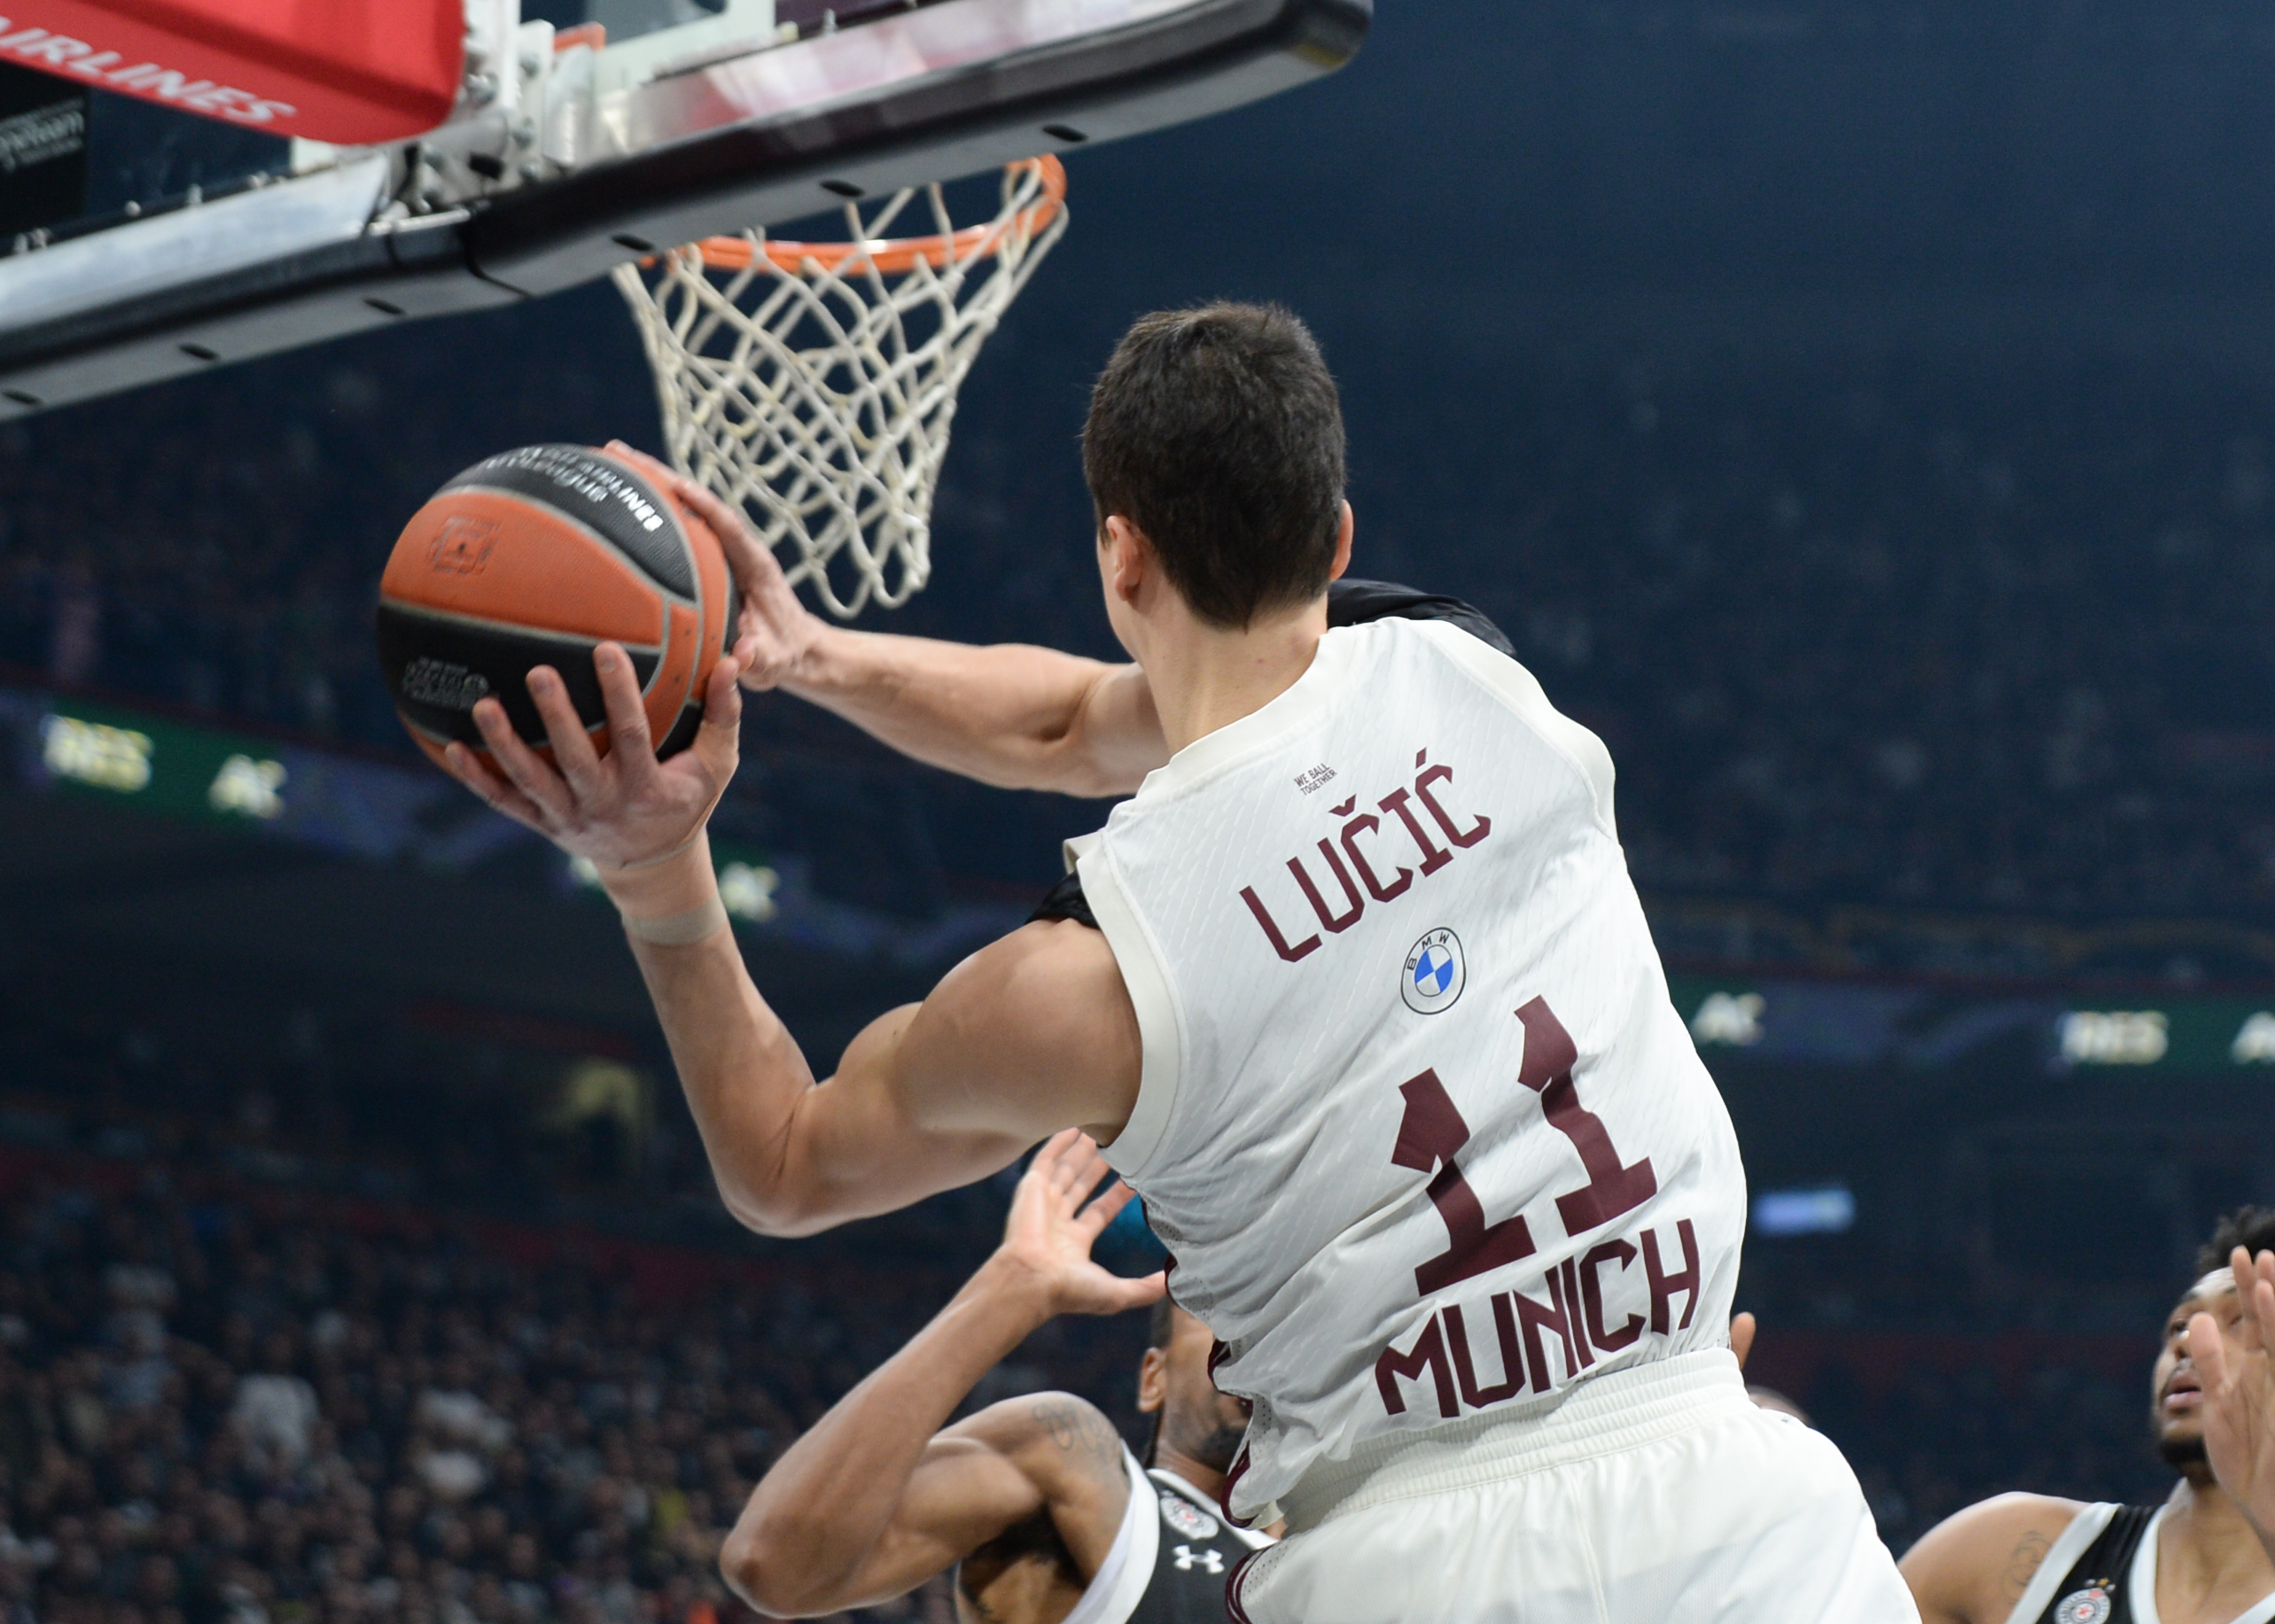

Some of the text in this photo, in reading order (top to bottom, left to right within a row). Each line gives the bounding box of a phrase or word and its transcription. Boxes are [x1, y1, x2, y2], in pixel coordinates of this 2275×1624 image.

[0, 15, 297, 122] IRLINES
[1294, 763, 1330, 788] WE BALL
[1300, 769, 1337, 796] TOGETHER
[1239, 747, 1492, 962] LUČIĆ
[1406, 931, 1450, 971] BMW
[1391, 995, 1657, 1297] 11
[1375, 1218, 1701, 1418] MUNICH
